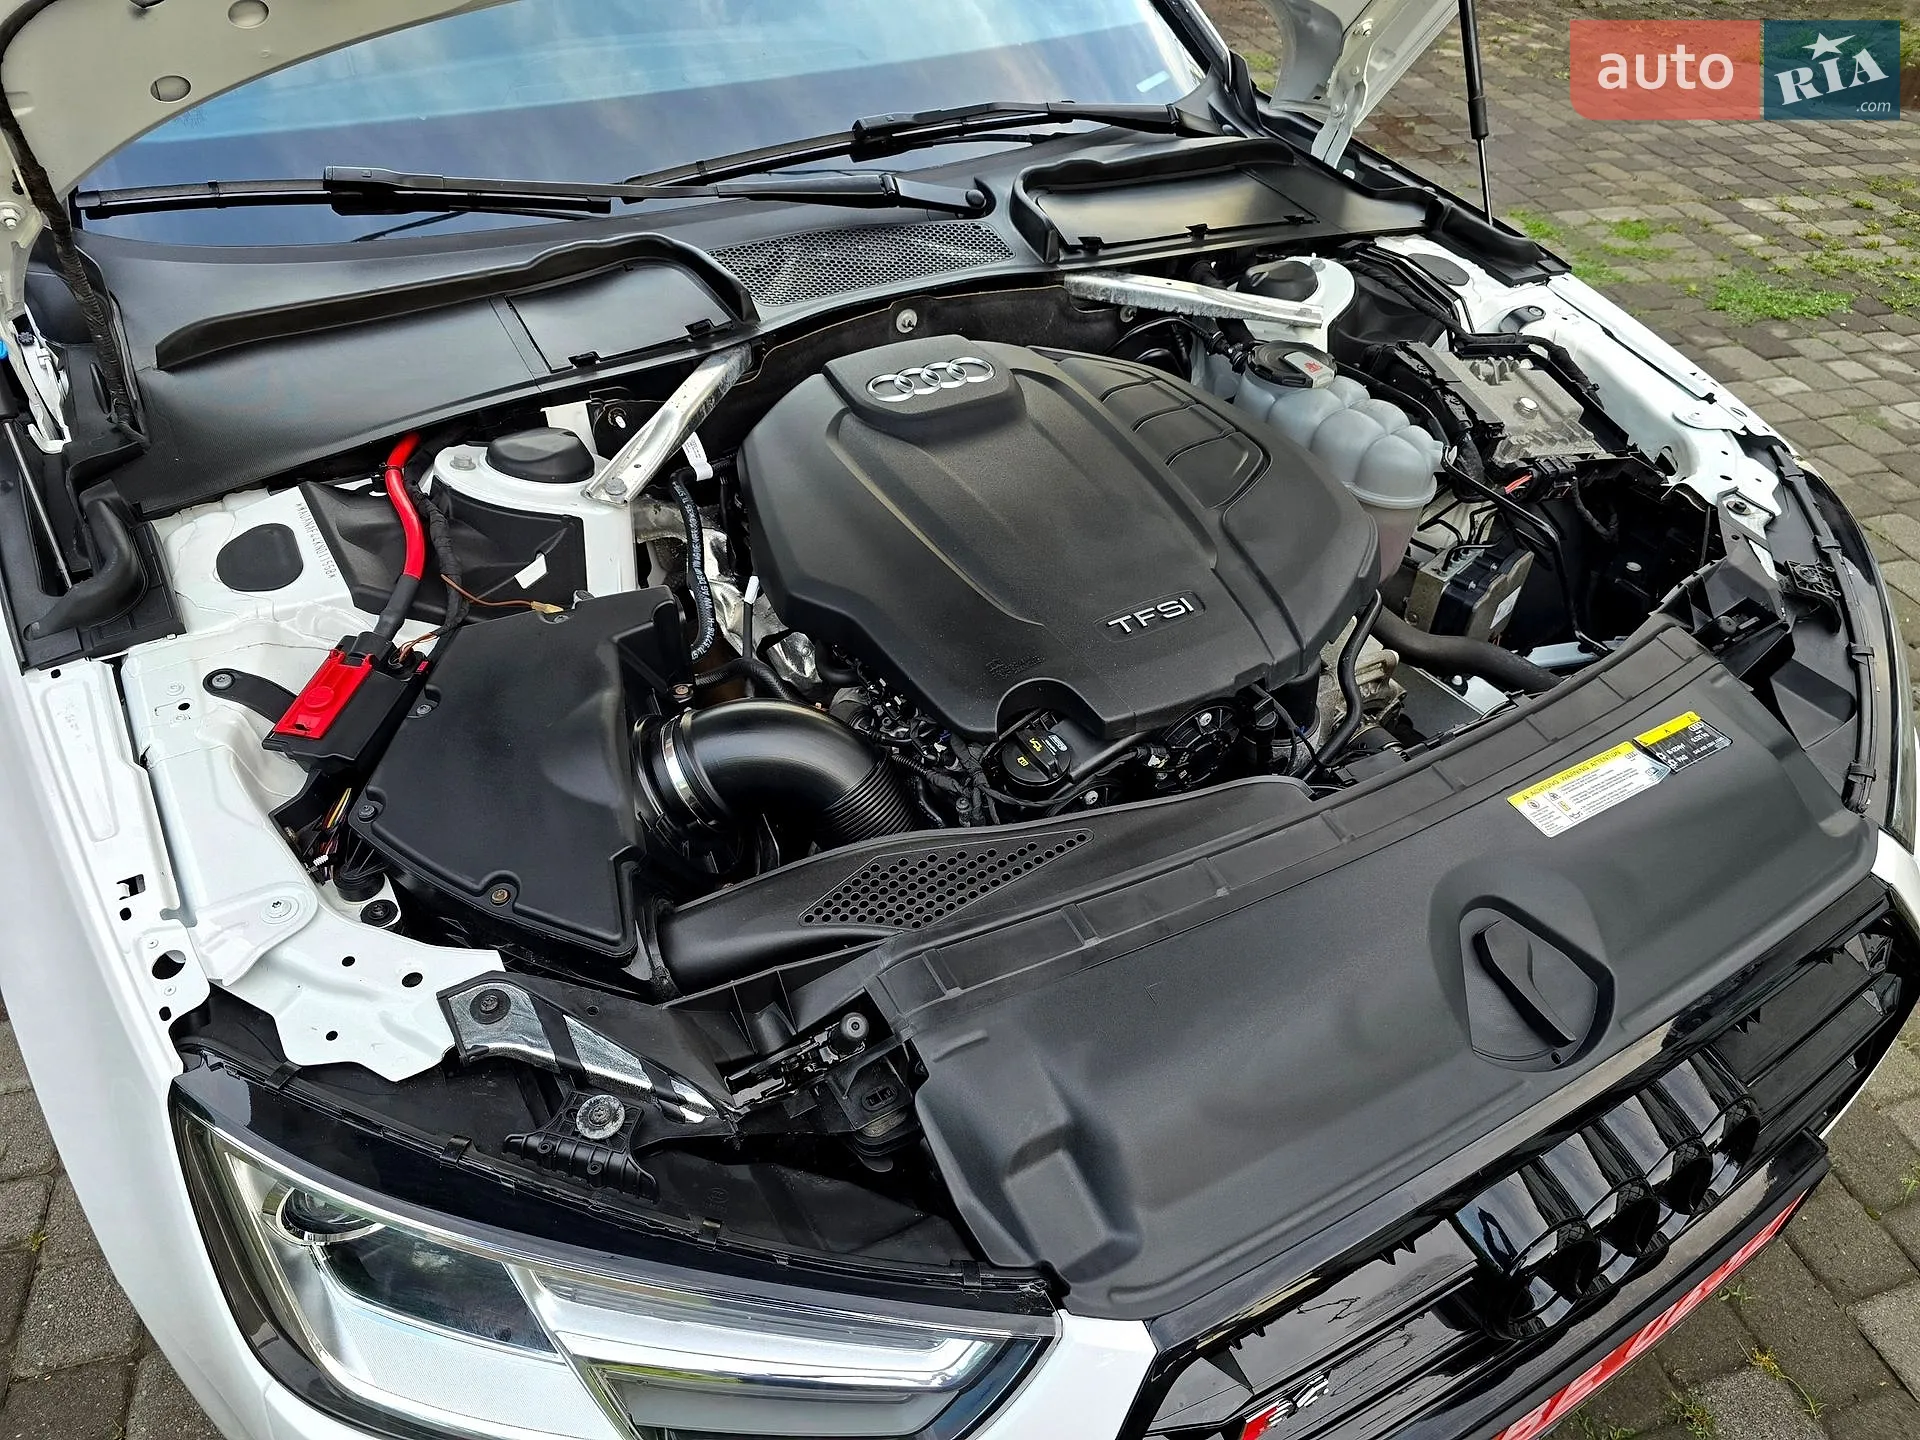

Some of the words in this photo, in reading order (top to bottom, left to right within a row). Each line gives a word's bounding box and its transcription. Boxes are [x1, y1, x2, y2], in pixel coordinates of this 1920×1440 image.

[1108, 597, 1194, 633] TFSI
[1530, 779, 1559, 798] ACHTUNG
[1560, 765, 1590, 782] WARNING
[1591, 751, 1621, 772] ATTENTION
